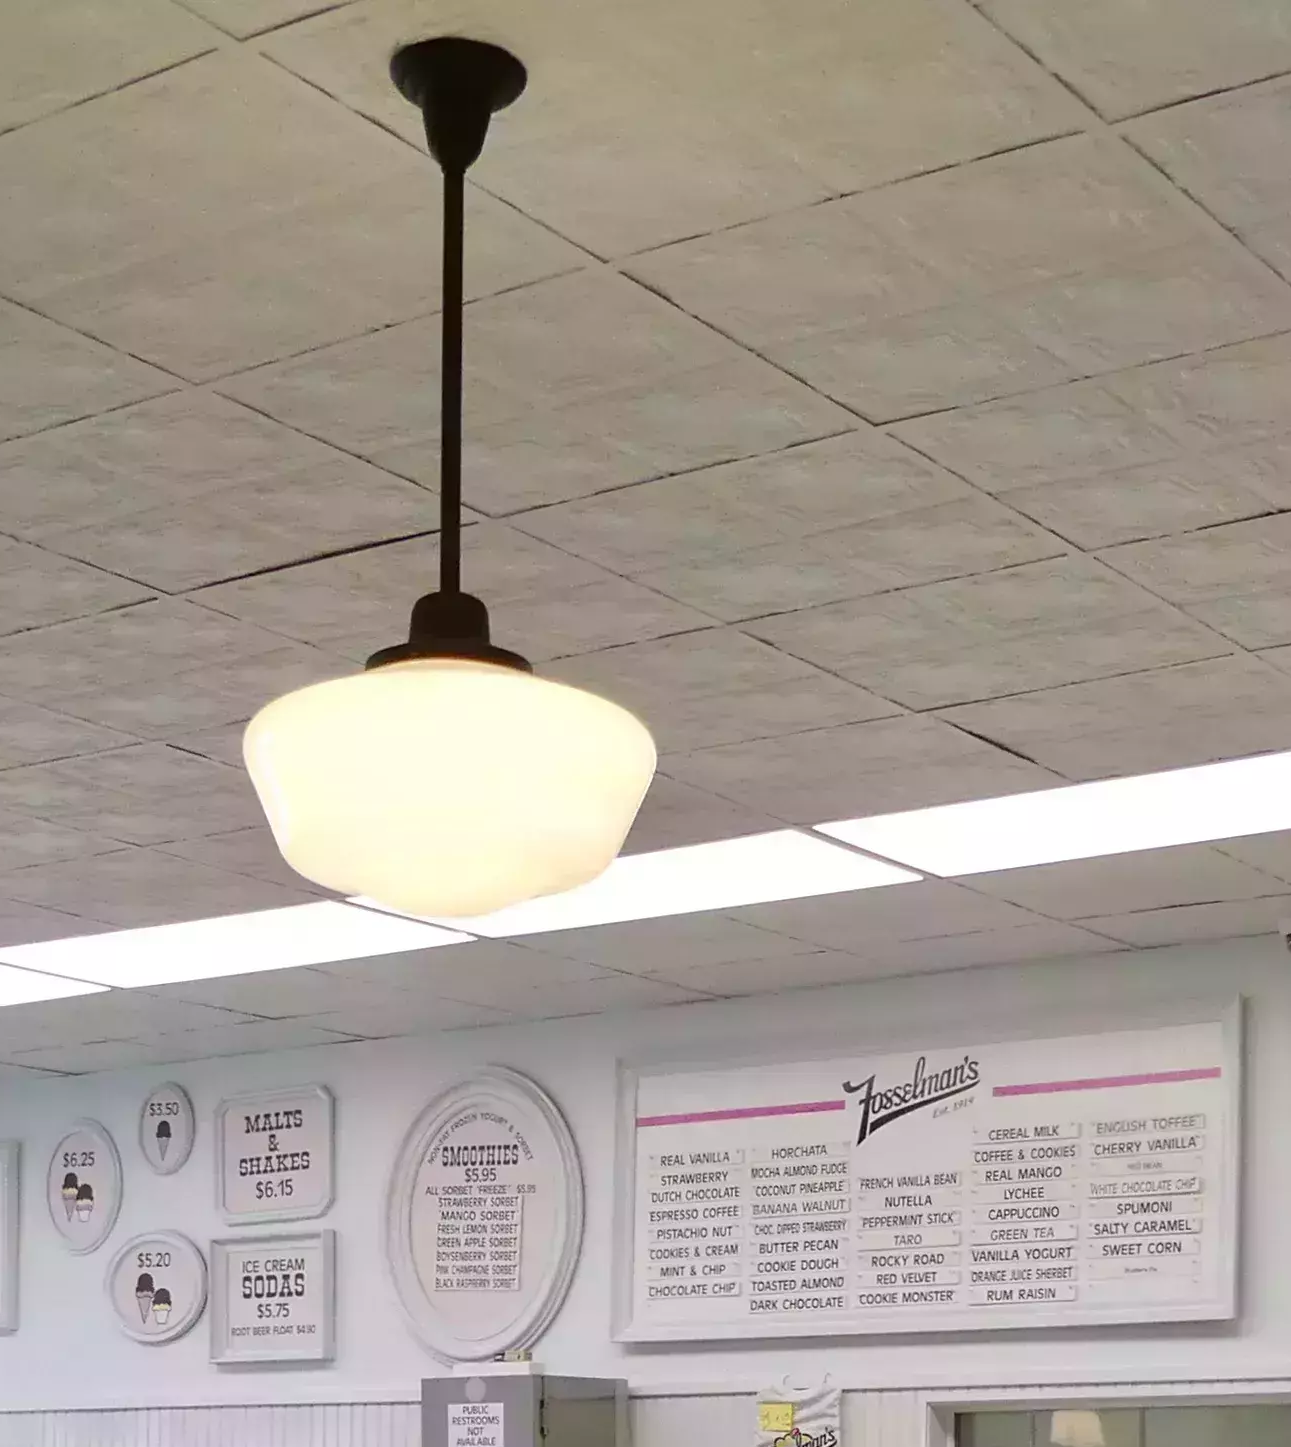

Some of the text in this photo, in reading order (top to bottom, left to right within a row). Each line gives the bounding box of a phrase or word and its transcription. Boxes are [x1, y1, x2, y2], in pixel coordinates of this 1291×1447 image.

[842, 1055, 980, 1147] Fosselman's
[244, 1109, 303, 1134] MALTS
[1096, 1115, 1197, 1134] ENGLISH TOFFEE
[988, 1125, 1060, 1141] CEREAL MILK
[268, 1134, 280, 1151] &
[1094, 1137, 1197, 1156] CHERRY VANILLA
[62, 1151, 95, 1168] $6.25
[441, 1144, 519, 1167] SMOOTHIES
[660, 1152, 730, 1166] REAL VANILLA
[771, 1145, 828, 1159] HORCHATA
[974, 1145, 1075, 1163] COFFEE & COOKIES
[239, 1151, 310, 1177] SHAKES
[751, 1162, 848, 1179] MOCHA ALMOND FUDGE
[464, 1167, 497, 1183] $5.95
[660, 1171, 728, 1186] STRAWBERRY
[860, 1173, 957, 1190] FRENCH VANILLA BEAN
[985, 1166, 1062, 1182] REAL MANGO
[255, 1178, 294, 1200] $6.15
[651, 1187, 740, 1203] DUTCH CHOCOLATE
[755, 1180, 844, 1197] COCONUT PINEAPPLE
[1003, 1187, 1044, 1200] LYCHEE
[490, 1196, 519, 1207] SORBET
[752, 1199, 846, 1216] BANANA WALNUT
[884, 1195, 933, 1208] NUTELLA
[1117, 1201, 1173, 1215] SPUMONI
[441, 1210, 516, 1221] MANGO SORBET
[650, 1206, 739, 1222] ESPRESSO COFFEE
[862, 1212, 954, 1228] PEPPERMINT STICK
[988, 1206, 1059, 1221] CAPPUCCINO
[657, 1226, 733, 1239] PISTACHIO NUT
[990, 1227, 1055, 1241] GREEN TEA
[1094, 1219, 1192, 1235] SALTY CARAMEL
[759, 1239, 839, 1254] BUTTER PECAN
[893, 1234, 923, 1246] TARO
[649, 1244, 738, 1260] COOKIES & CREAM
[972, 1246, 1072, 1262] VANILLA YOGURT
[1102, 1241, 1182, 1256] SWEET CORN
[137, 1252, 171, 1269] $5.20
[242, 1258, 305, 1273] ICE CREAM
[757, 1258, 839, 1273] COOKIE DOUGH
[871, 1253, 945, 1267] ROCKY ROAD
[660, 1264, 726, 1276] MINT & CHIP
[752, 1277, 844, 1292] TOASTED ALMOND
[876, 1271, 938, 1285] RED VELVET
[242, 1273, 306, 1299] SODAS
[648, 1282, 736, 1297] CHOCOLATE CHIP
[859, 1290, 953, 1305] COOKIE MONSTER
[987, 1287, 1056, 1302] RUM RAISIN
[257, 1302, 290, 1319] $5.75
[750, 1296, 844, 1311] DARK CHOCOLATE
[462, 1405, 489, 1415] PUBLIC
[452, 1416, 500, 1425] RESTROOMS
[467, 1427, 484, 1436] NOT
[457, 1437, 497, 1446] AVAILABLE
